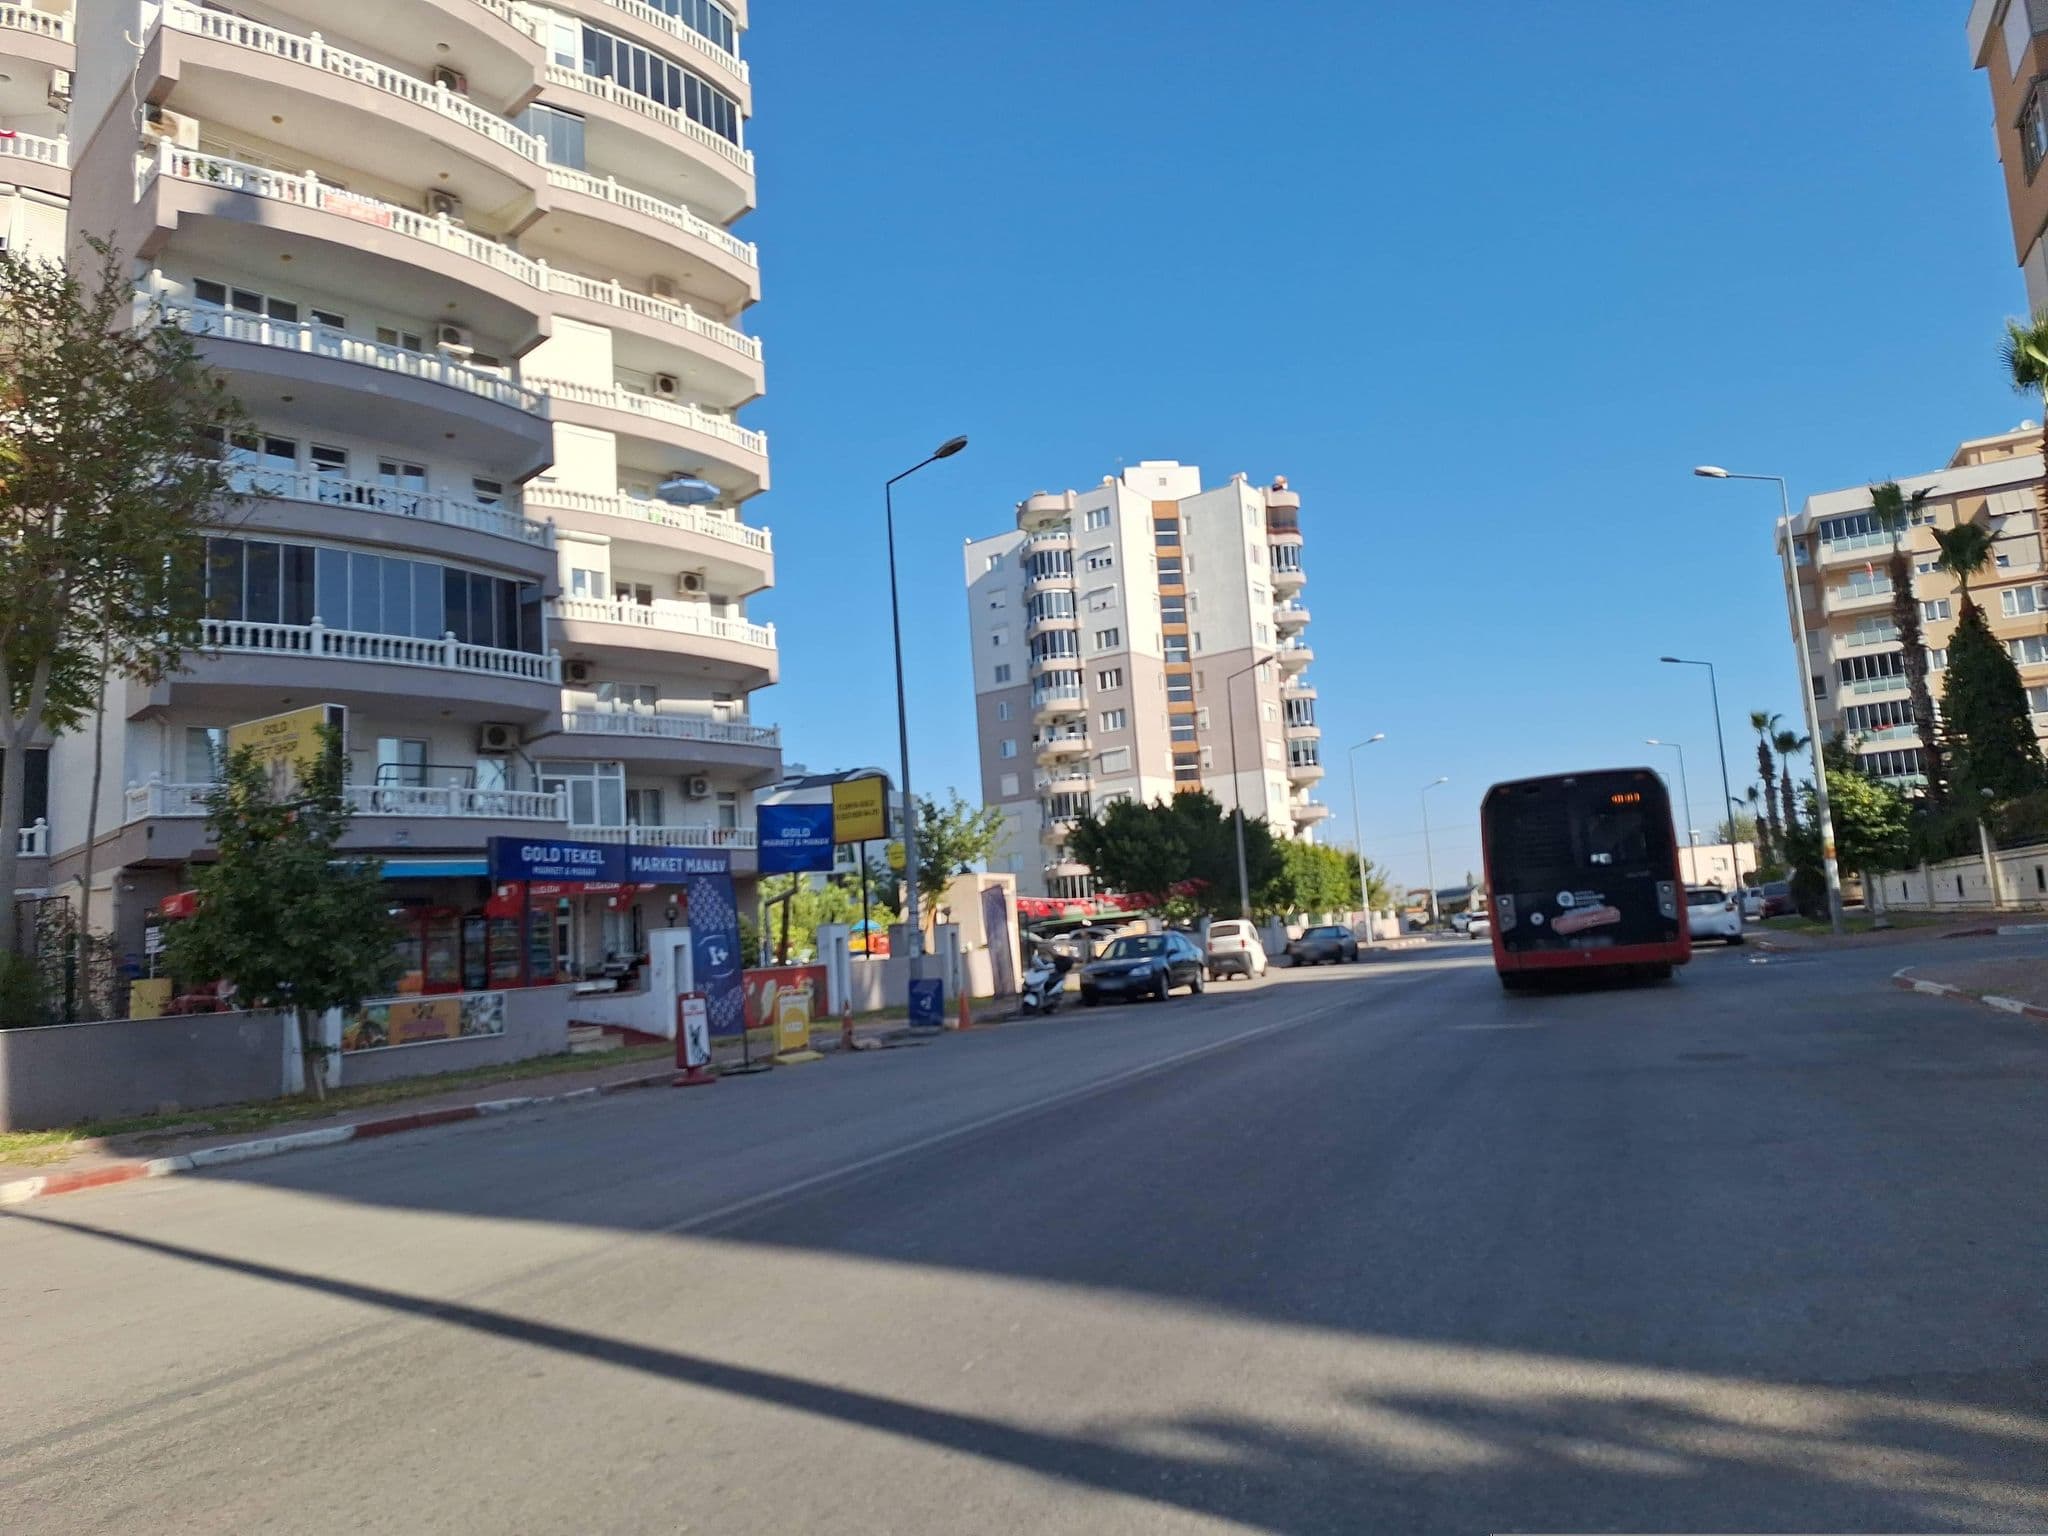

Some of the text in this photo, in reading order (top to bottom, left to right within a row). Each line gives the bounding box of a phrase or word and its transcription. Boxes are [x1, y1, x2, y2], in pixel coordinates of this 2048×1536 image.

[781, 827, 811, 838] GOLD
[762, 838, 795, 848] MARKET
[521, 845, 606, 865] GOLD TEKEL
[631, 856, 727, 873] MARKET MANAV
[532, 866, 565, 876] MARKET
